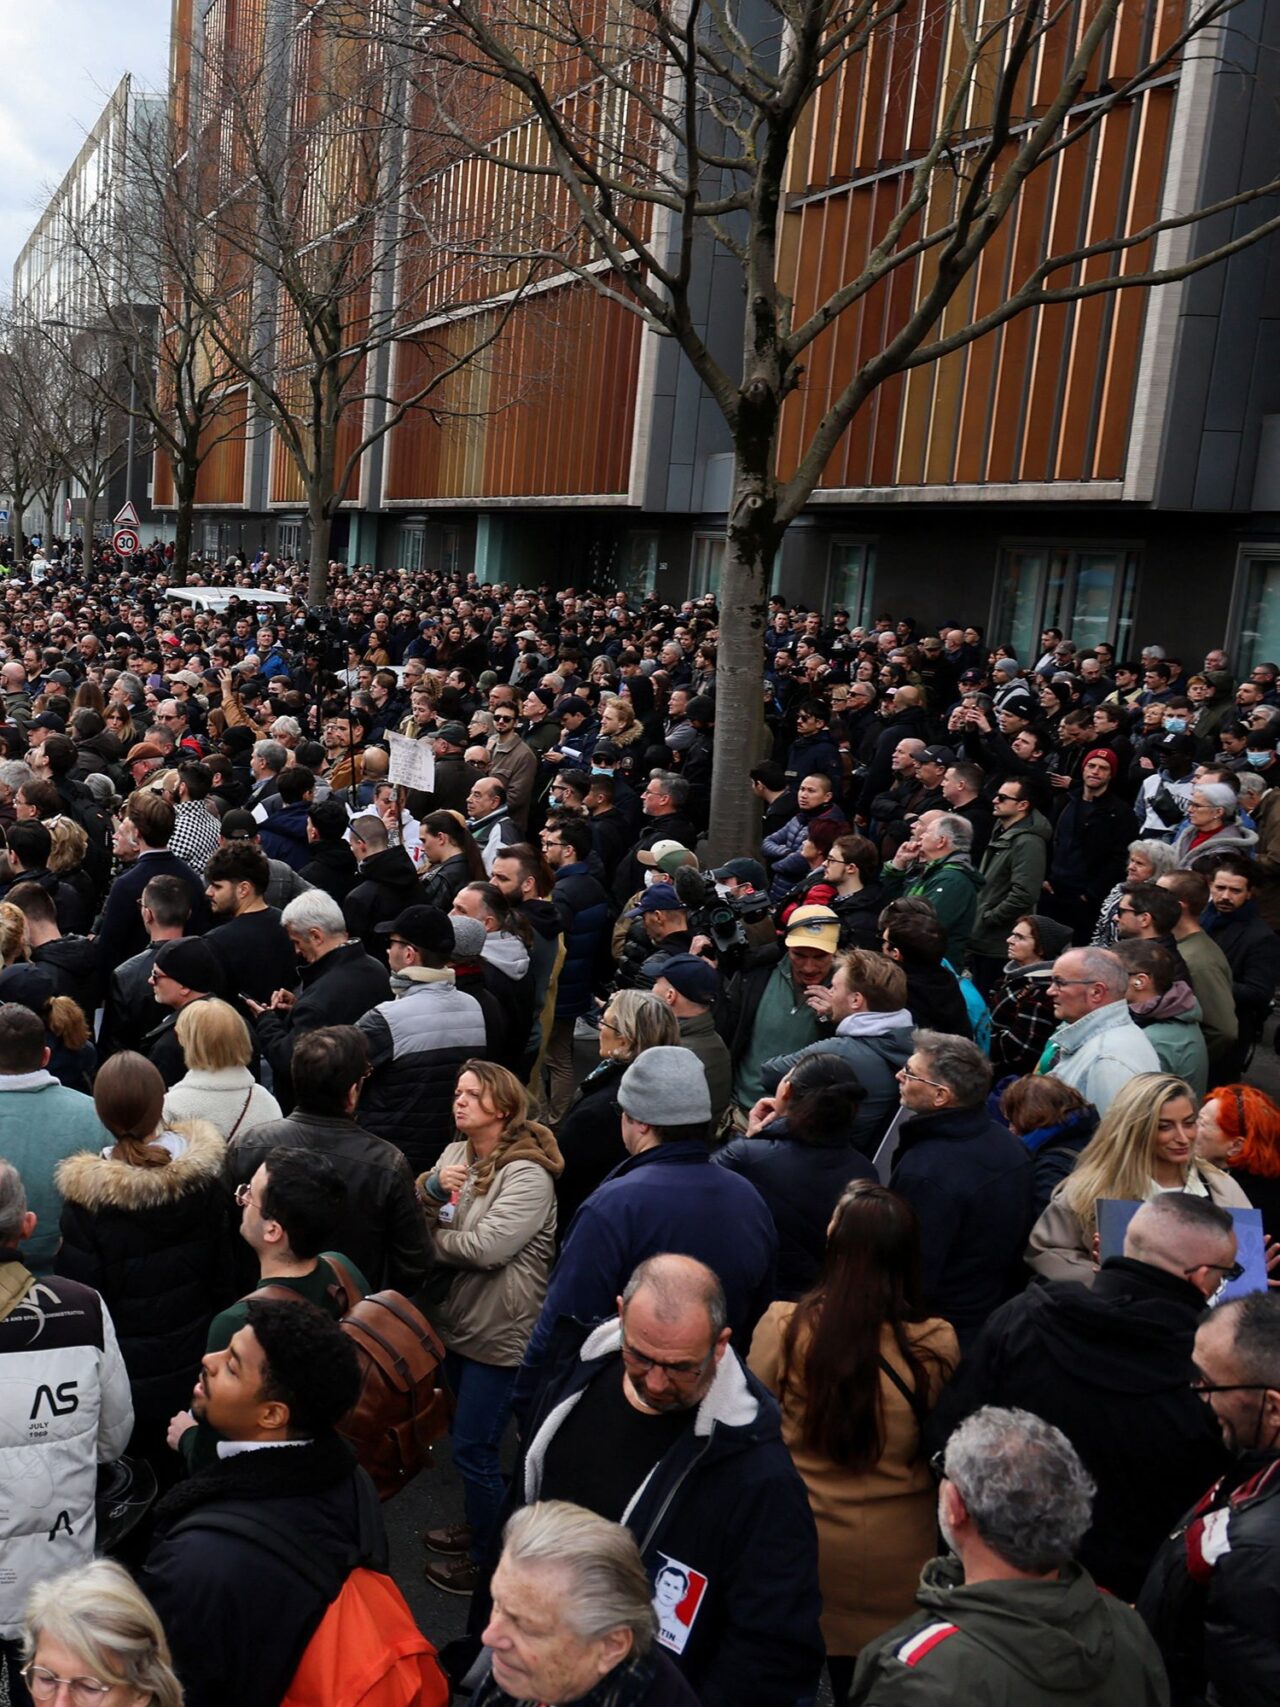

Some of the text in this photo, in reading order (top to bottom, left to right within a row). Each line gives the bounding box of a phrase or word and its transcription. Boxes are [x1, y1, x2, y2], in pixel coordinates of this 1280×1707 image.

[119, 537, 133, 548] 30
[29, 1381, 79, 1420] AS
[29, 1422, 49, 1430] JULY
